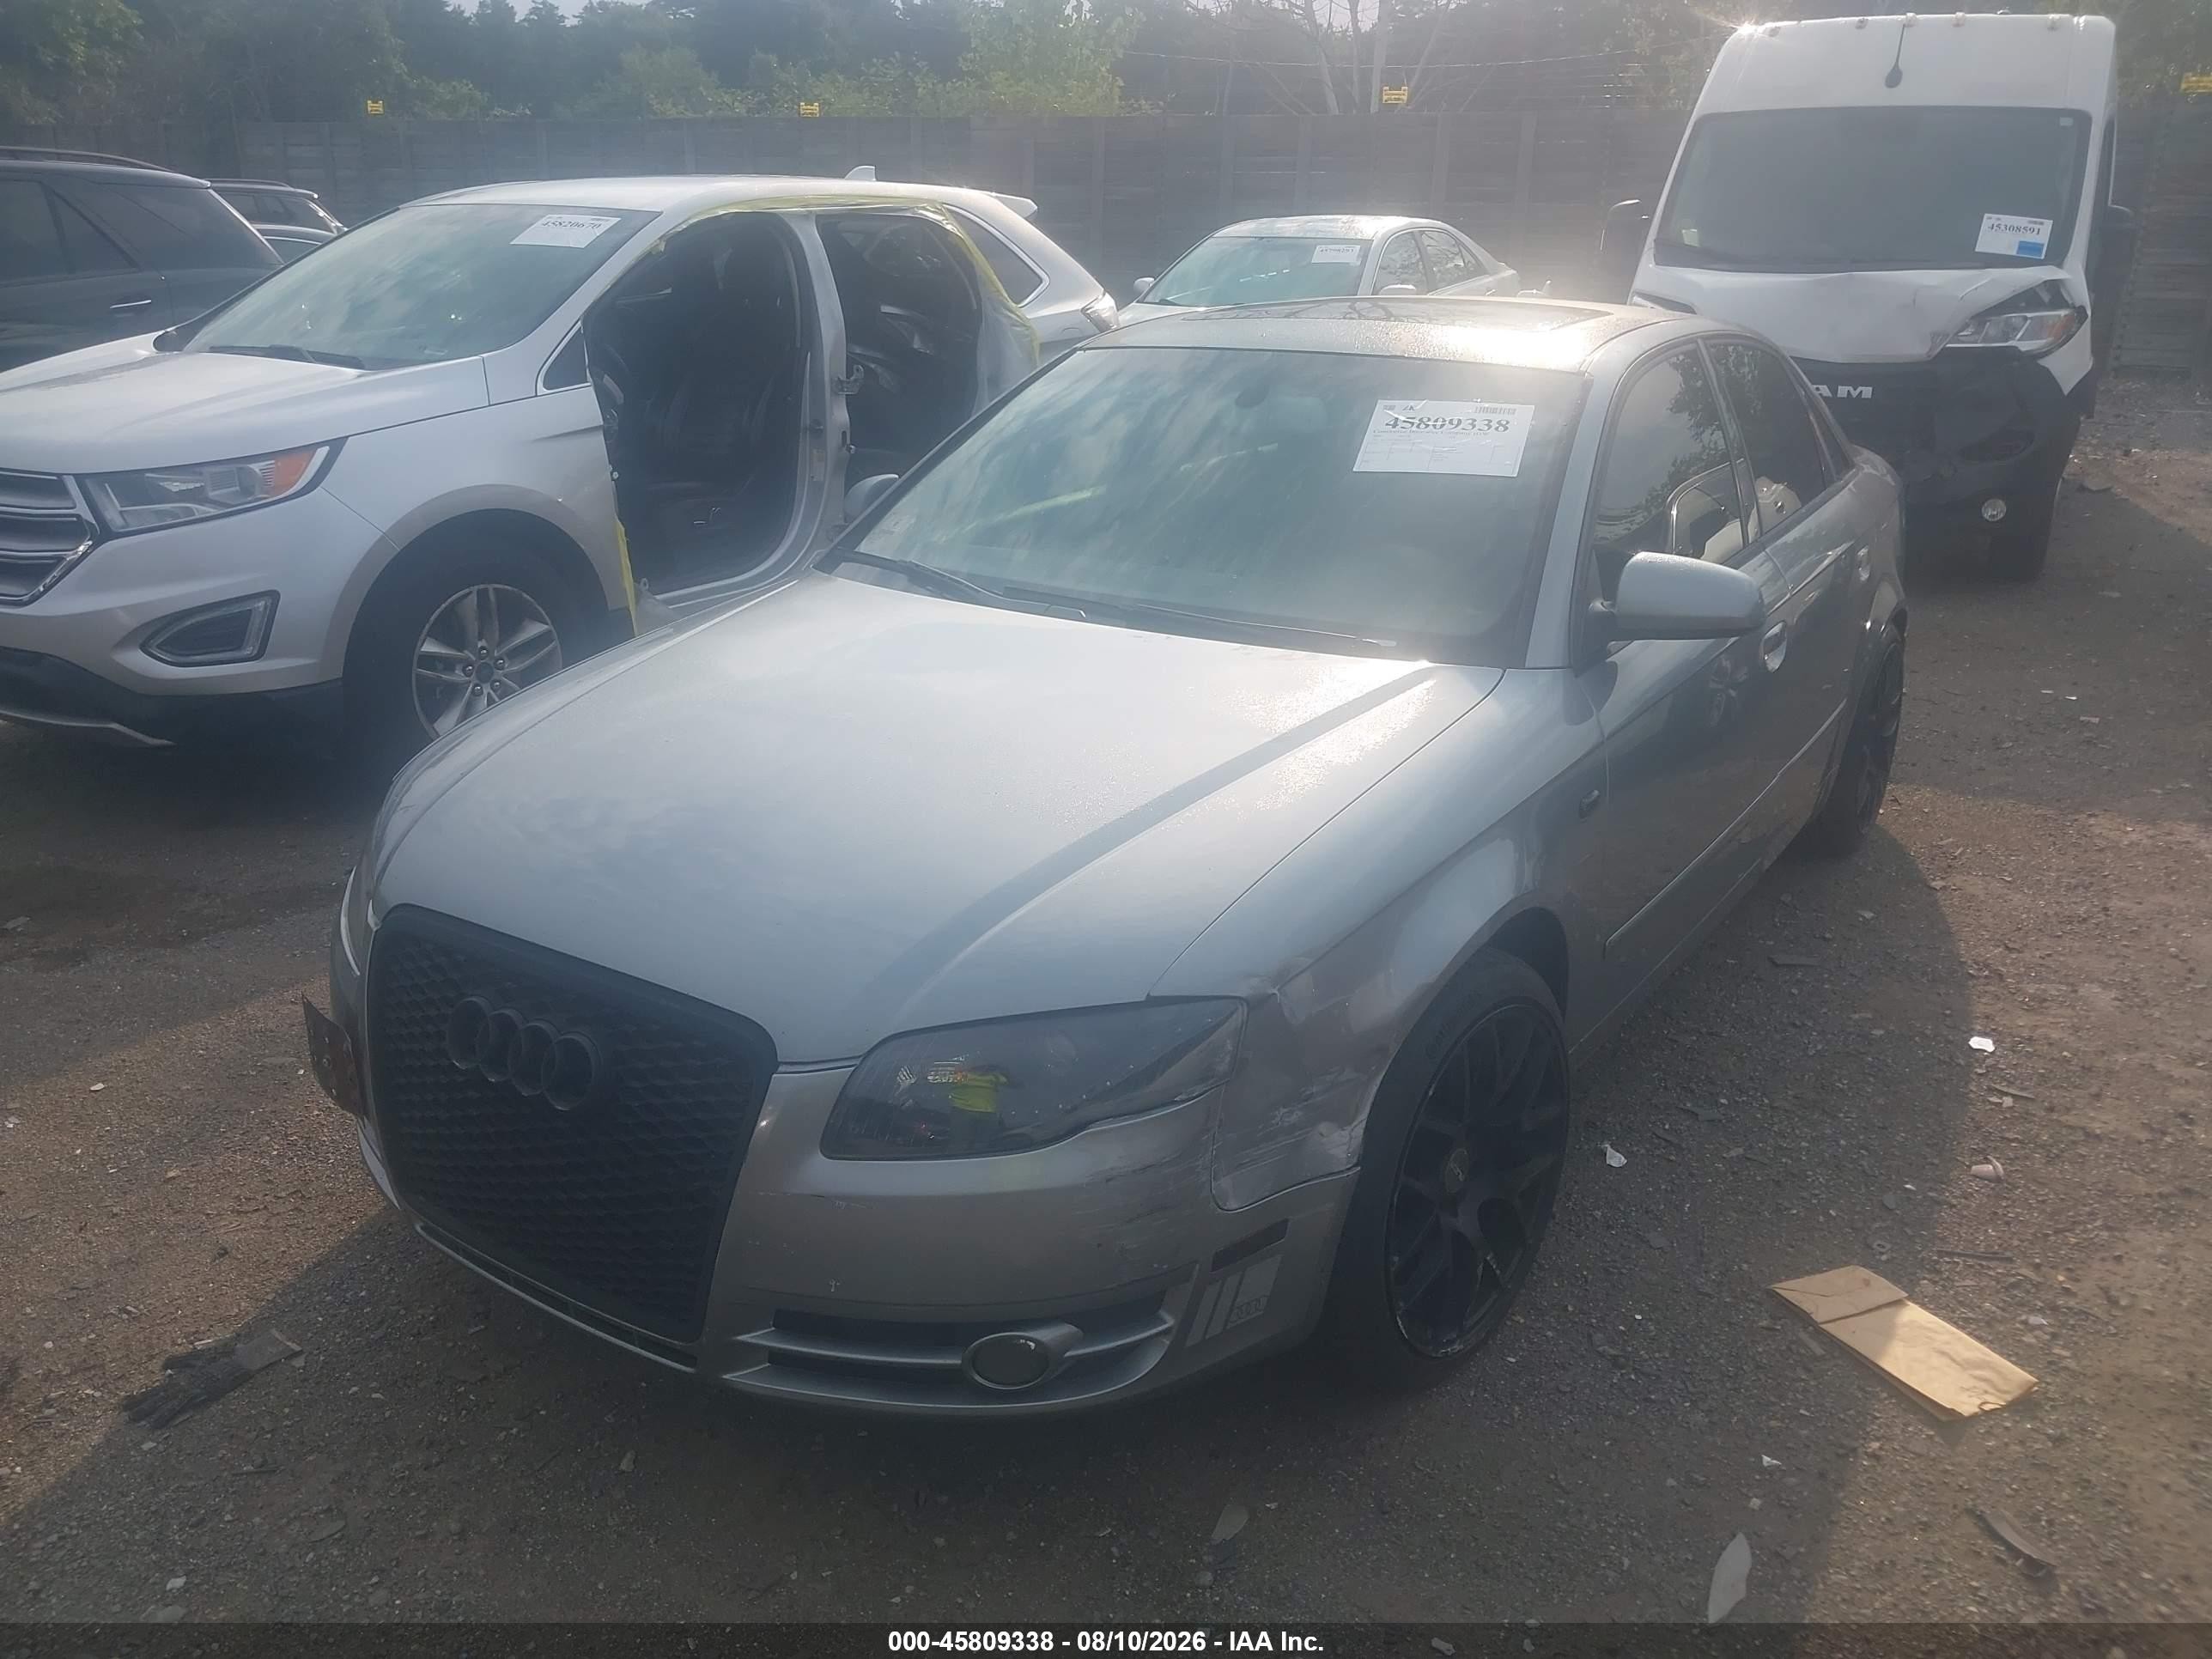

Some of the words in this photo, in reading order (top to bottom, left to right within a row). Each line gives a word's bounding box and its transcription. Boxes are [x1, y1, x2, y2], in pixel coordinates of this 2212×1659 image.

[1988, 223, 2041, 235] 45308591
[1812, 385, 1873, 398] AM
[1385, 416, 1510, 433] 45809338
